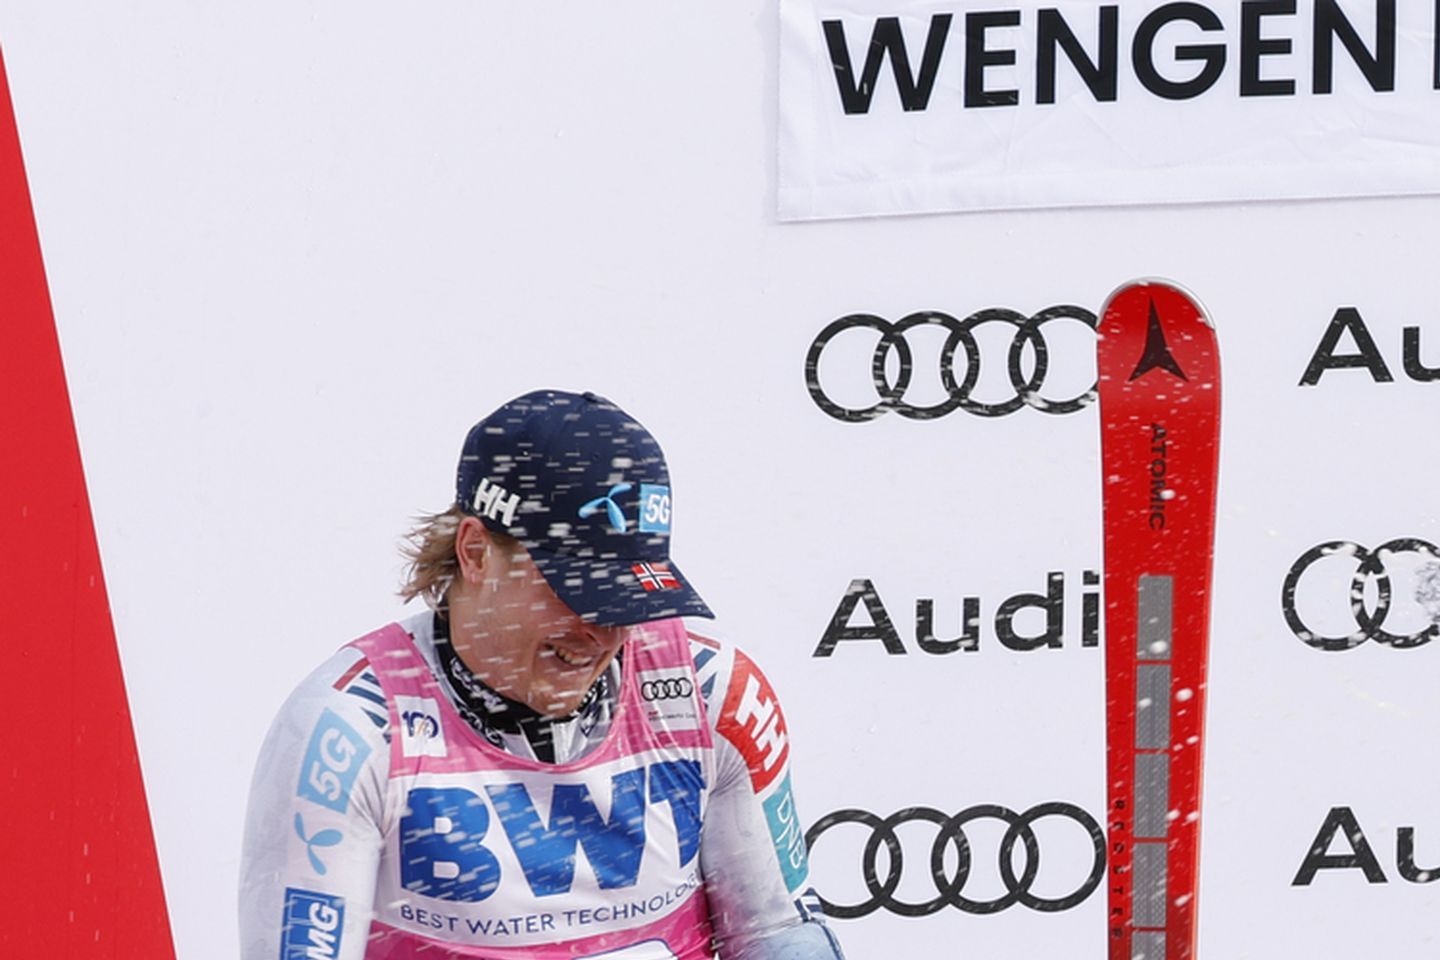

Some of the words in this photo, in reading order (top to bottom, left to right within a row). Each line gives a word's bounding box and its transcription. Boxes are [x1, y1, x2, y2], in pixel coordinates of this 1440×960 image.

[821, 0, 1396, 115] WENGEN
[474, 477, 521, 527] HH
[644, 494, 671, 524] 5G
[1150, 422, 1168, 531] ATOMIC
[812, 570, 1100, 657] Audi
[309, 727, 358, 801] 5G
[735, 672, 787, 772] HH
[400, 759, 702, 903] BWT
[401, 903, 458, 932] BEST
[466, 912, 556, 936] WATER
